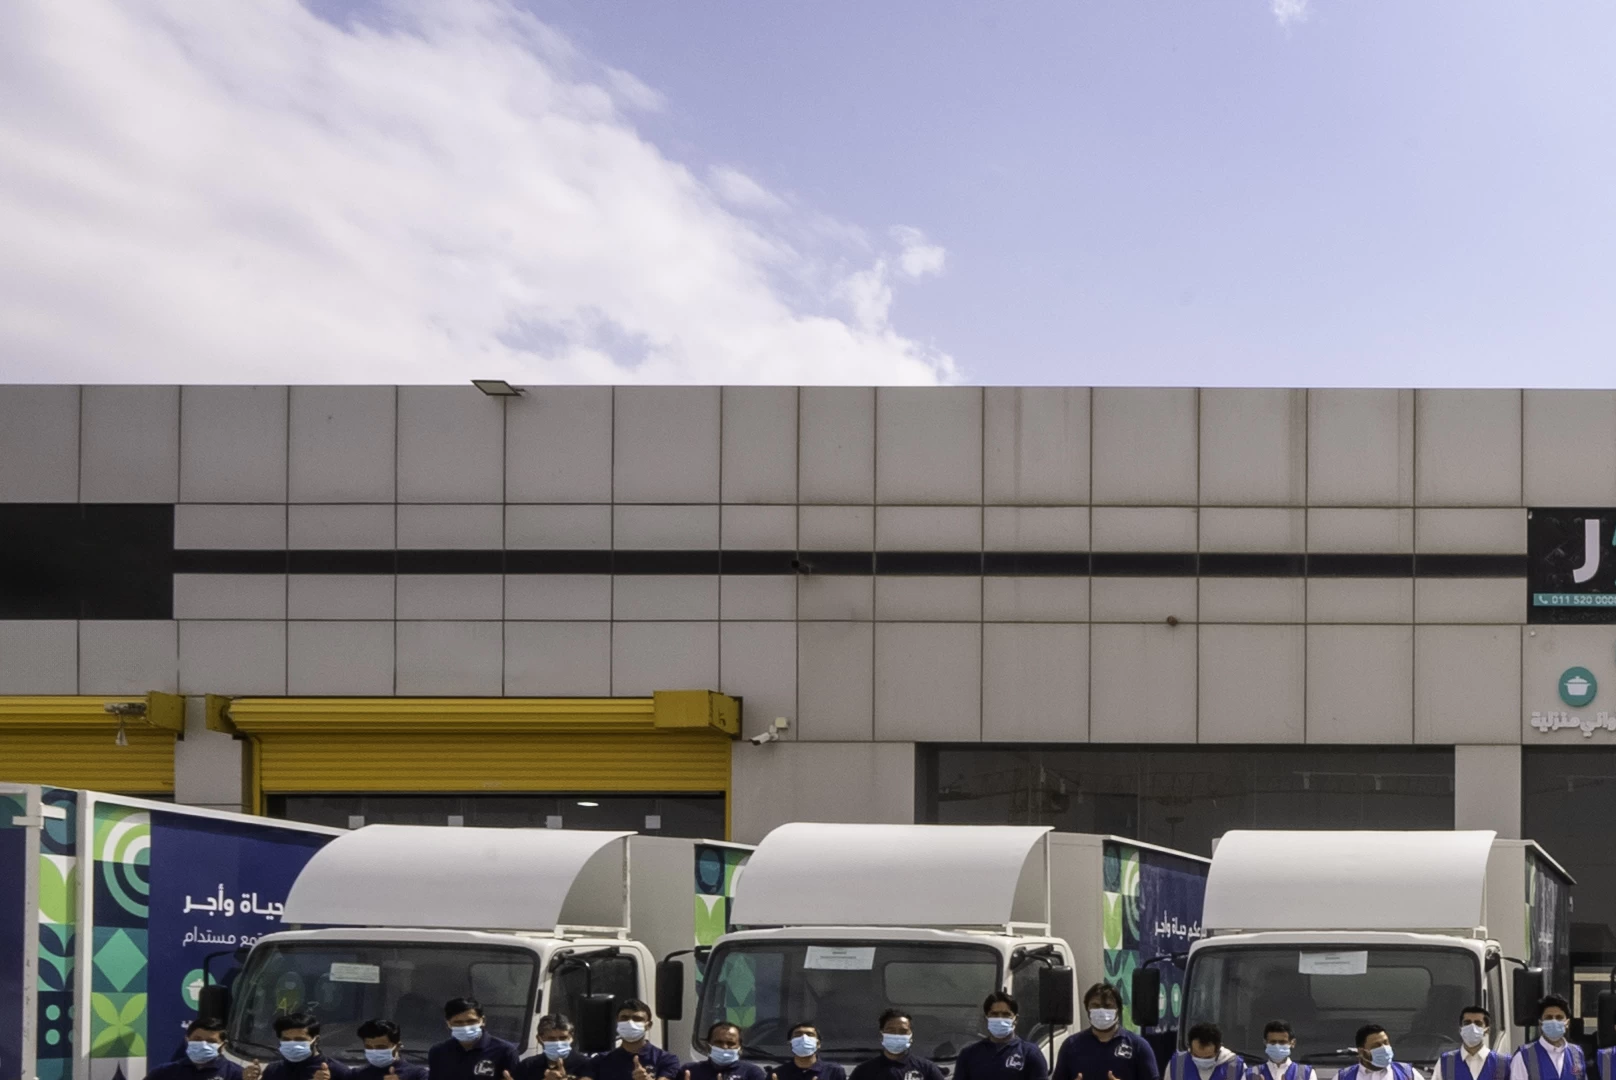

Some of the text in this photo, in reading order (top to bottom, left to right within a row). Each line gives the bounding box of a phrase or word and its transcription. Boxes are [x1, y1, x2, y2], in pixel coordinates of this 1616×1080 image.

[1551, 595, 1571, 606] 011
[1573, 595, 1593, 606] 520
[182, 883, 235, 917] وأجر
[182, 925, 237, 947] مستدام
